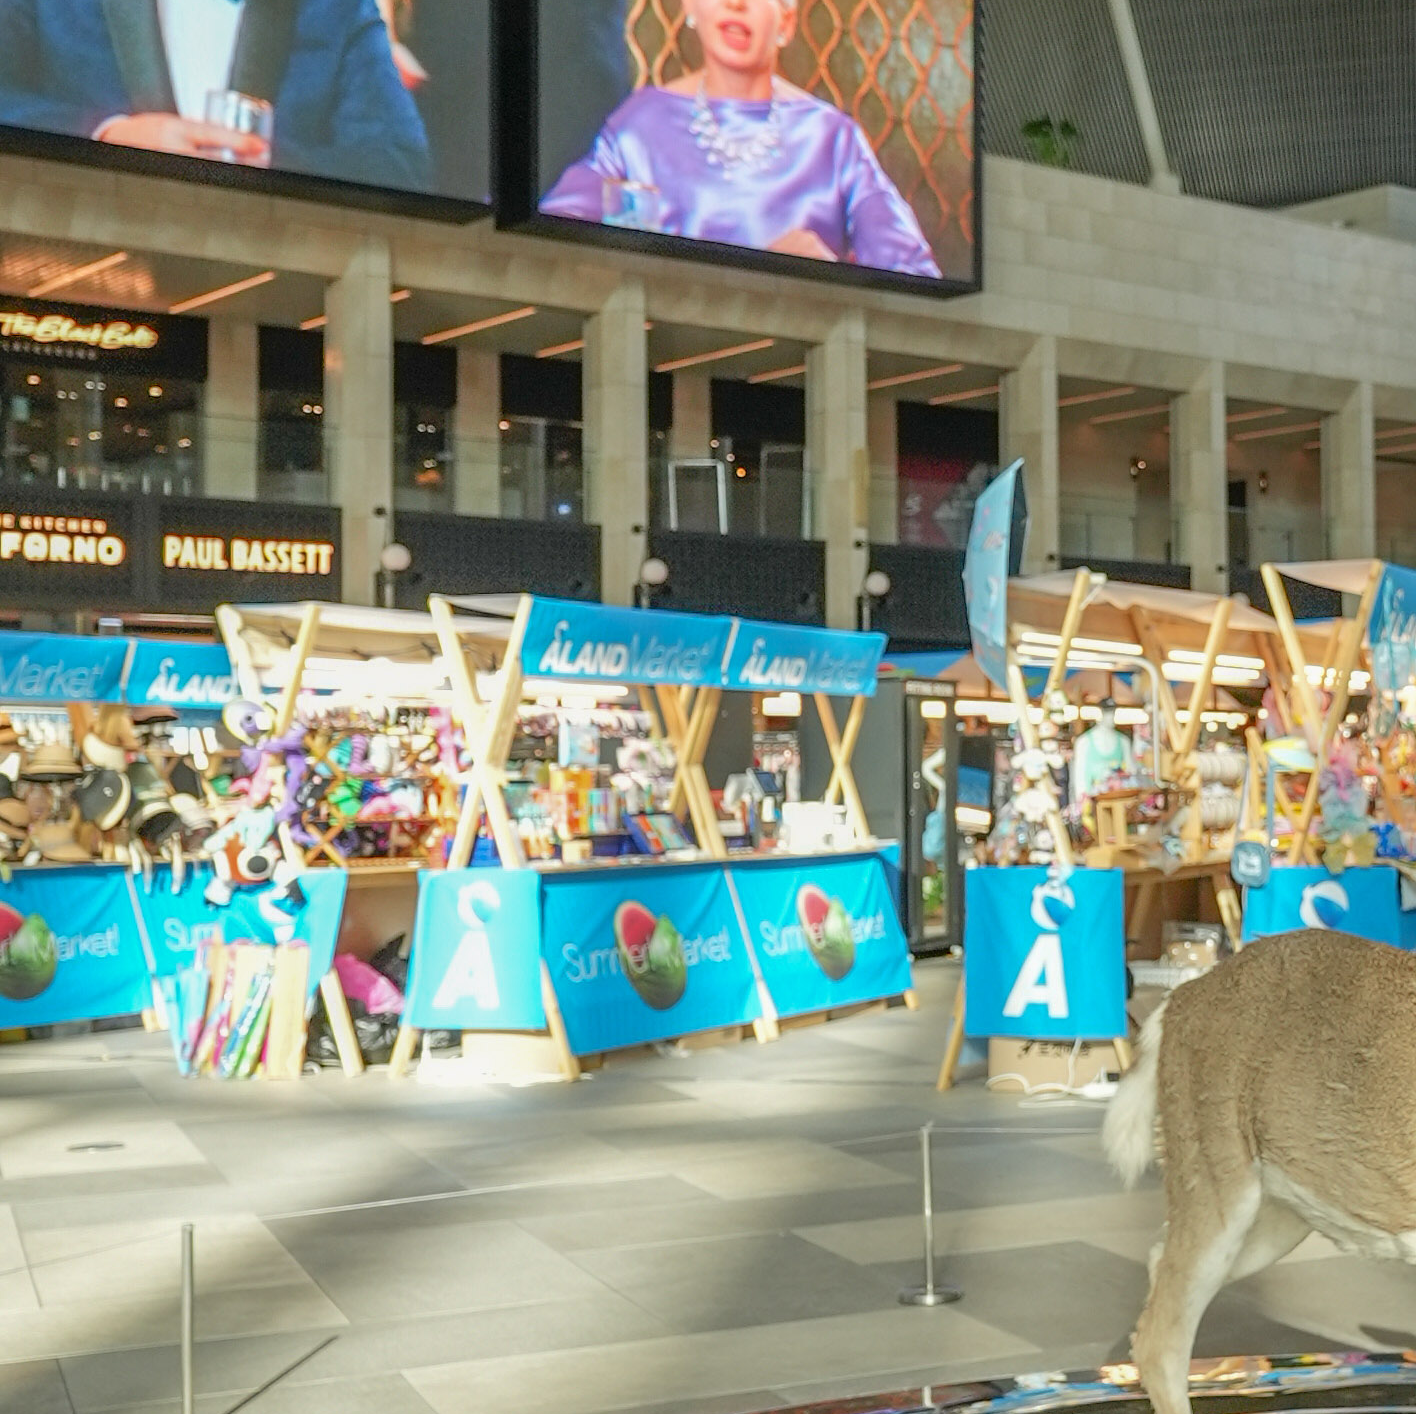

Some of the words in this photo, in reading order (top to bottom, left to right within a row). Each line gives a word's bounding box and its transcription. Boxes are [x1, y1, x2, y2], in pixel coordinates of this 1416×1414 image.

[0, 530, 126, 566] FORNO
[163, 533, 229, 571] PAUL
[230, 537, 335, 575] BASSETT
